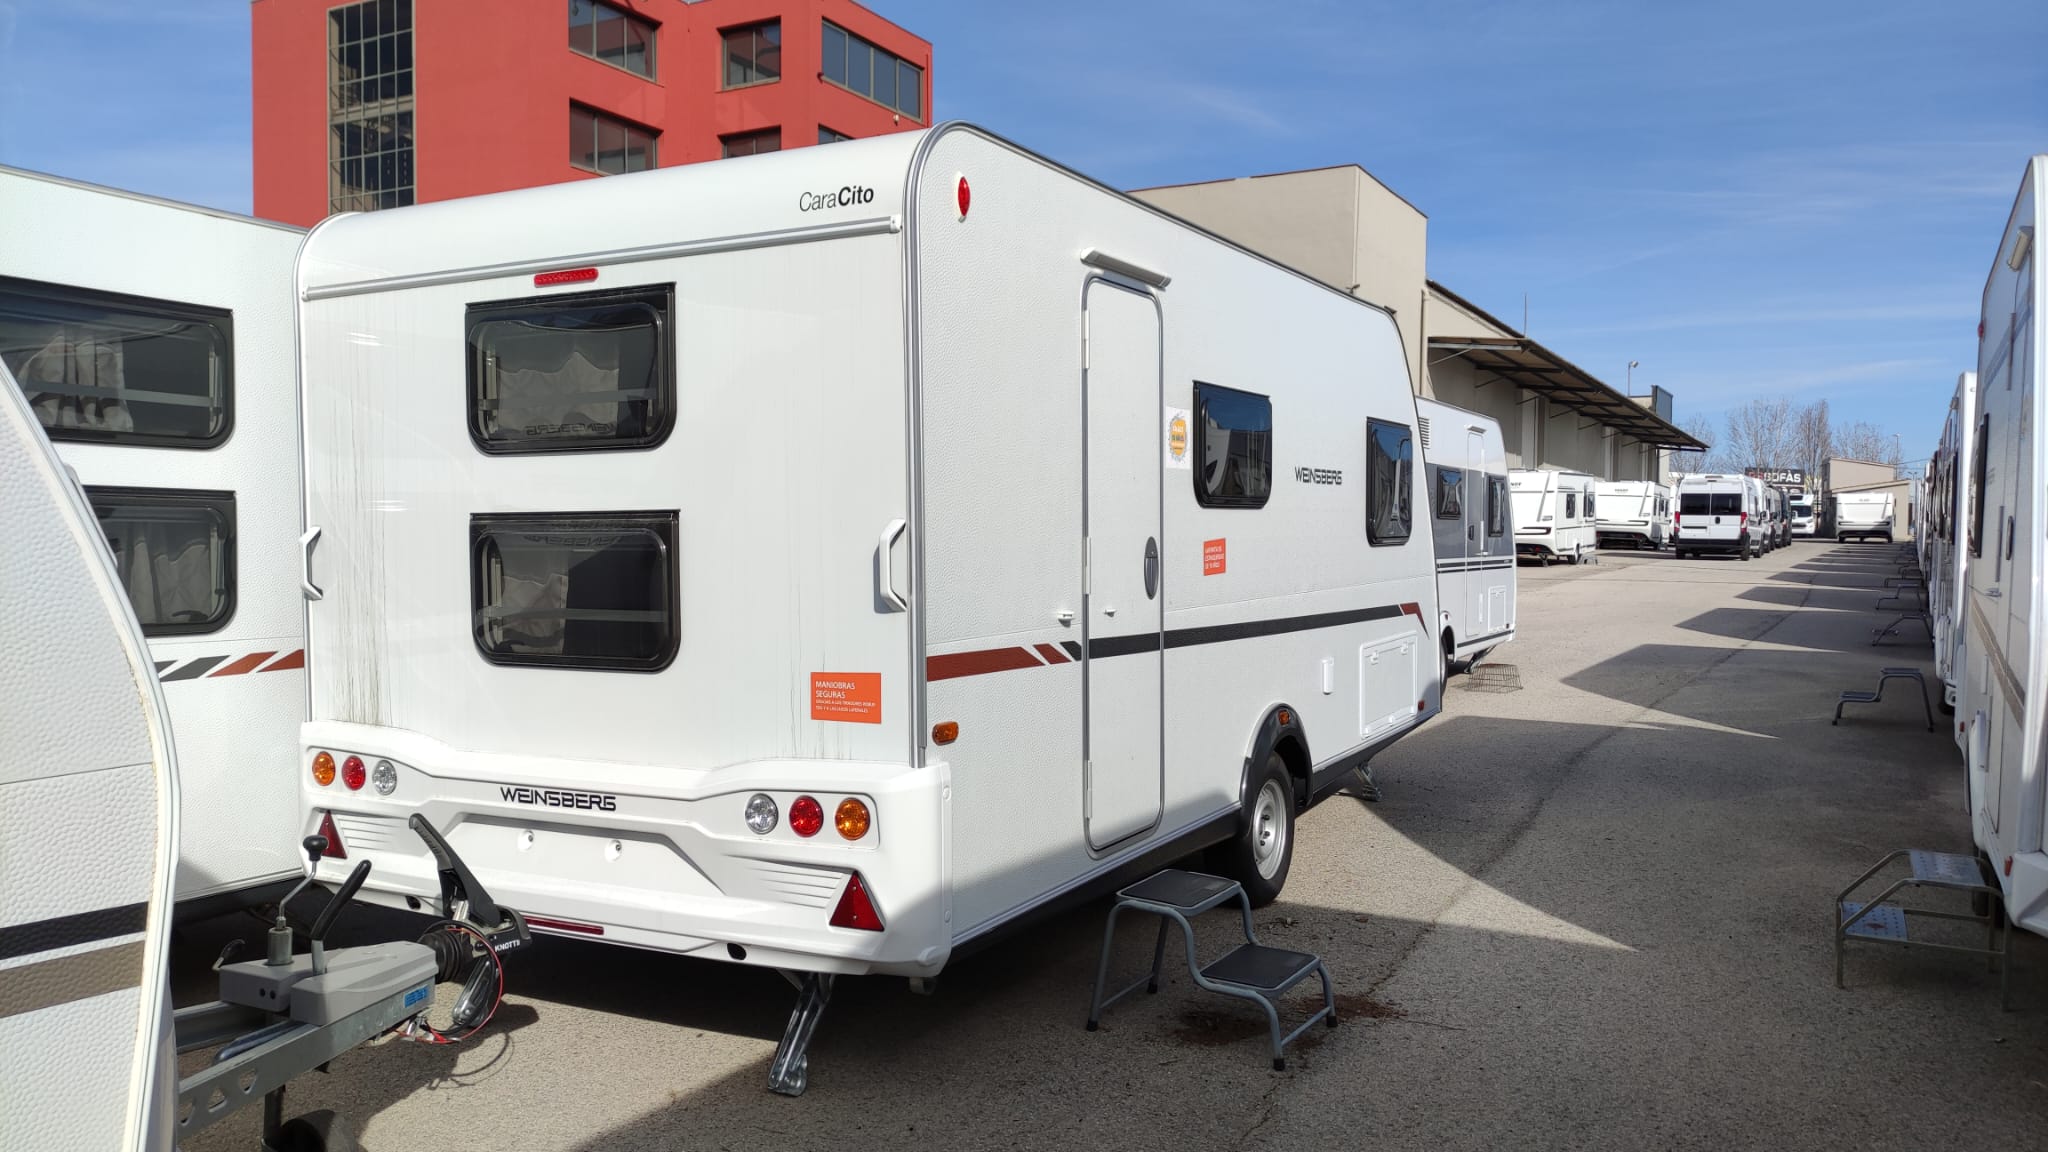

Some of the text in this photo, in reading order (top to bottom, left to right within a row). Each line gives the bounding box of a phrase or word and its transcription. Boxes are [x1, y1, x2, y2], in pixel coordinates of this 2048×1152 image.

[799, 185, 874, 212] CaraCito
[1294, 466, 1342, 486] WEINSBERG
[815, 681, 856, 690] MANIOBRAS
[815, 690, 846, 699] SEGURAS
[500, 786, 617, 812] WEINSBERG
